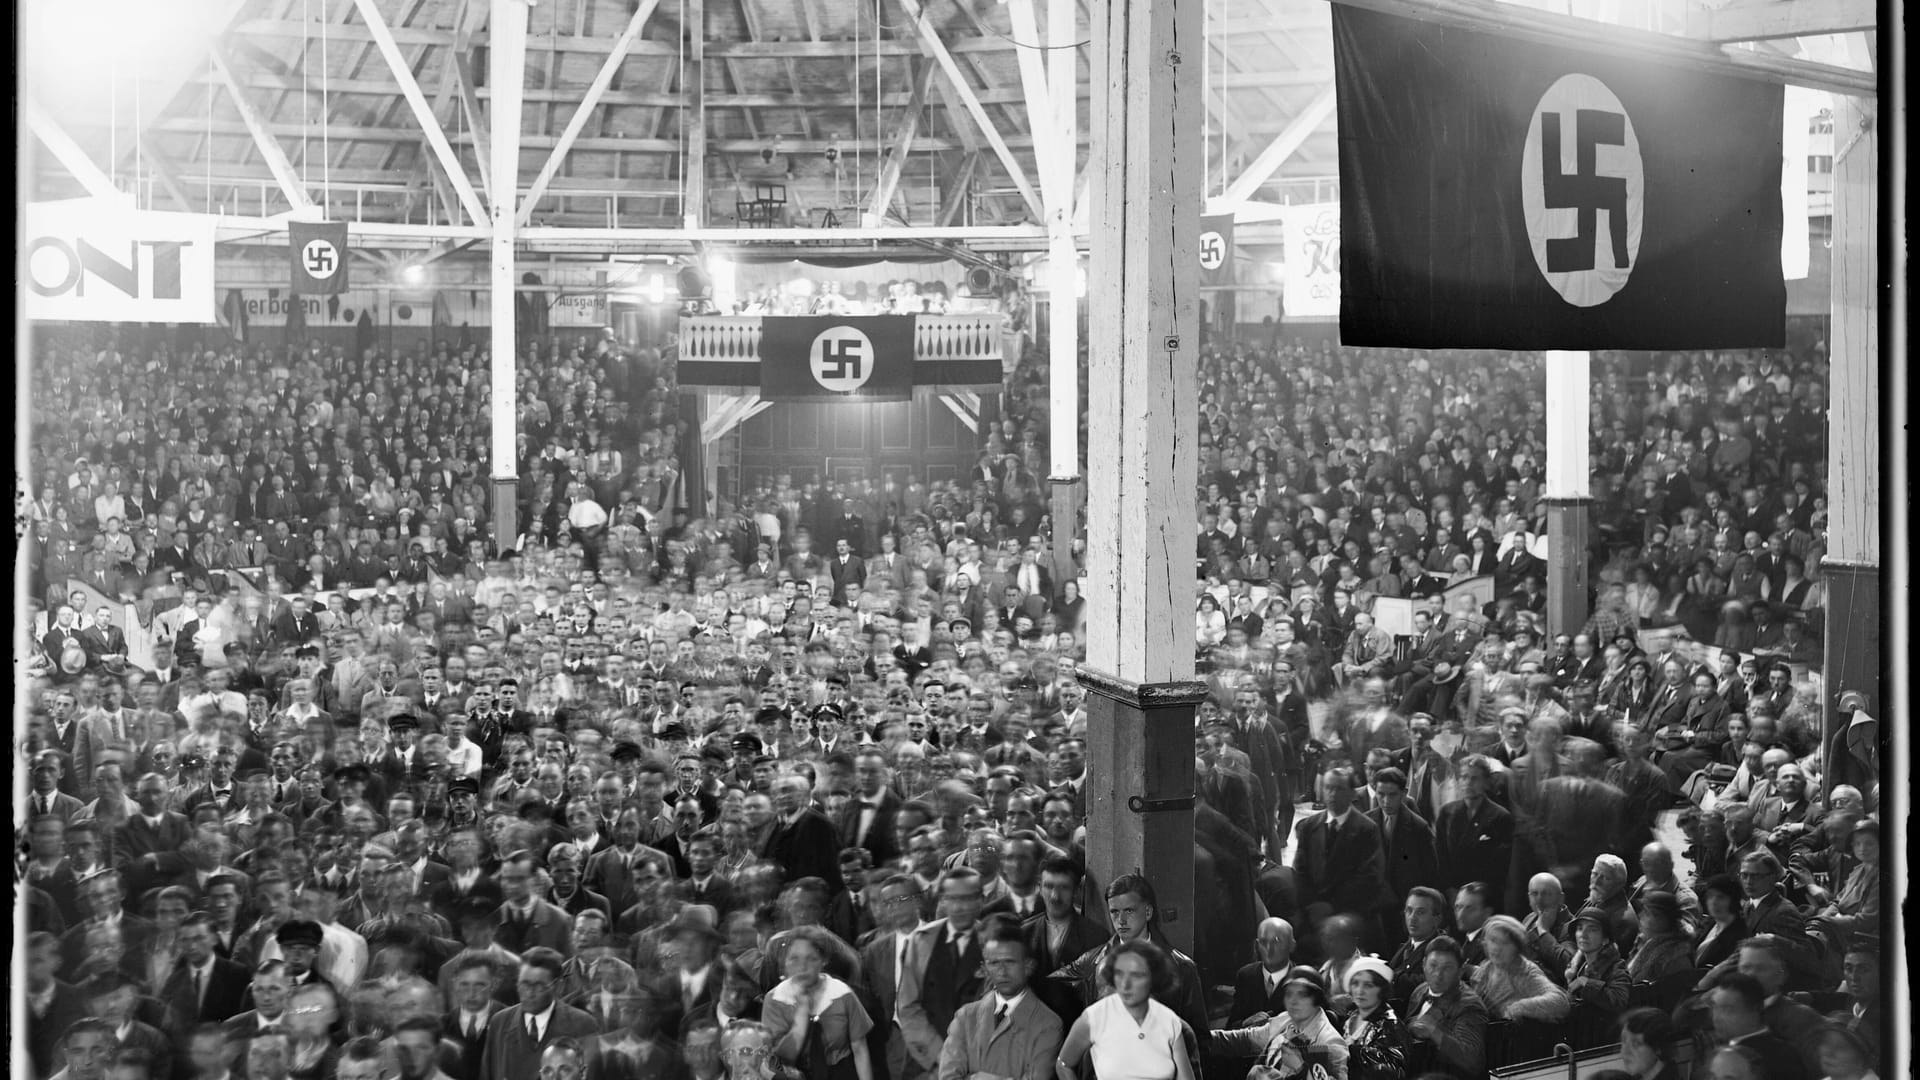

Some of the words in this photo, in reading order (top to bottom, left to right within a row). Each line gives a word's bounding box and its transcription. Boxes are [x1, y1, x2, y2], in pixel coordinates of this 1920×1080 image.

[26, 236, 193, 299] ONT
[243, 297, 320, 314] erboen
[559, 295, 605, 310] Ausgang
